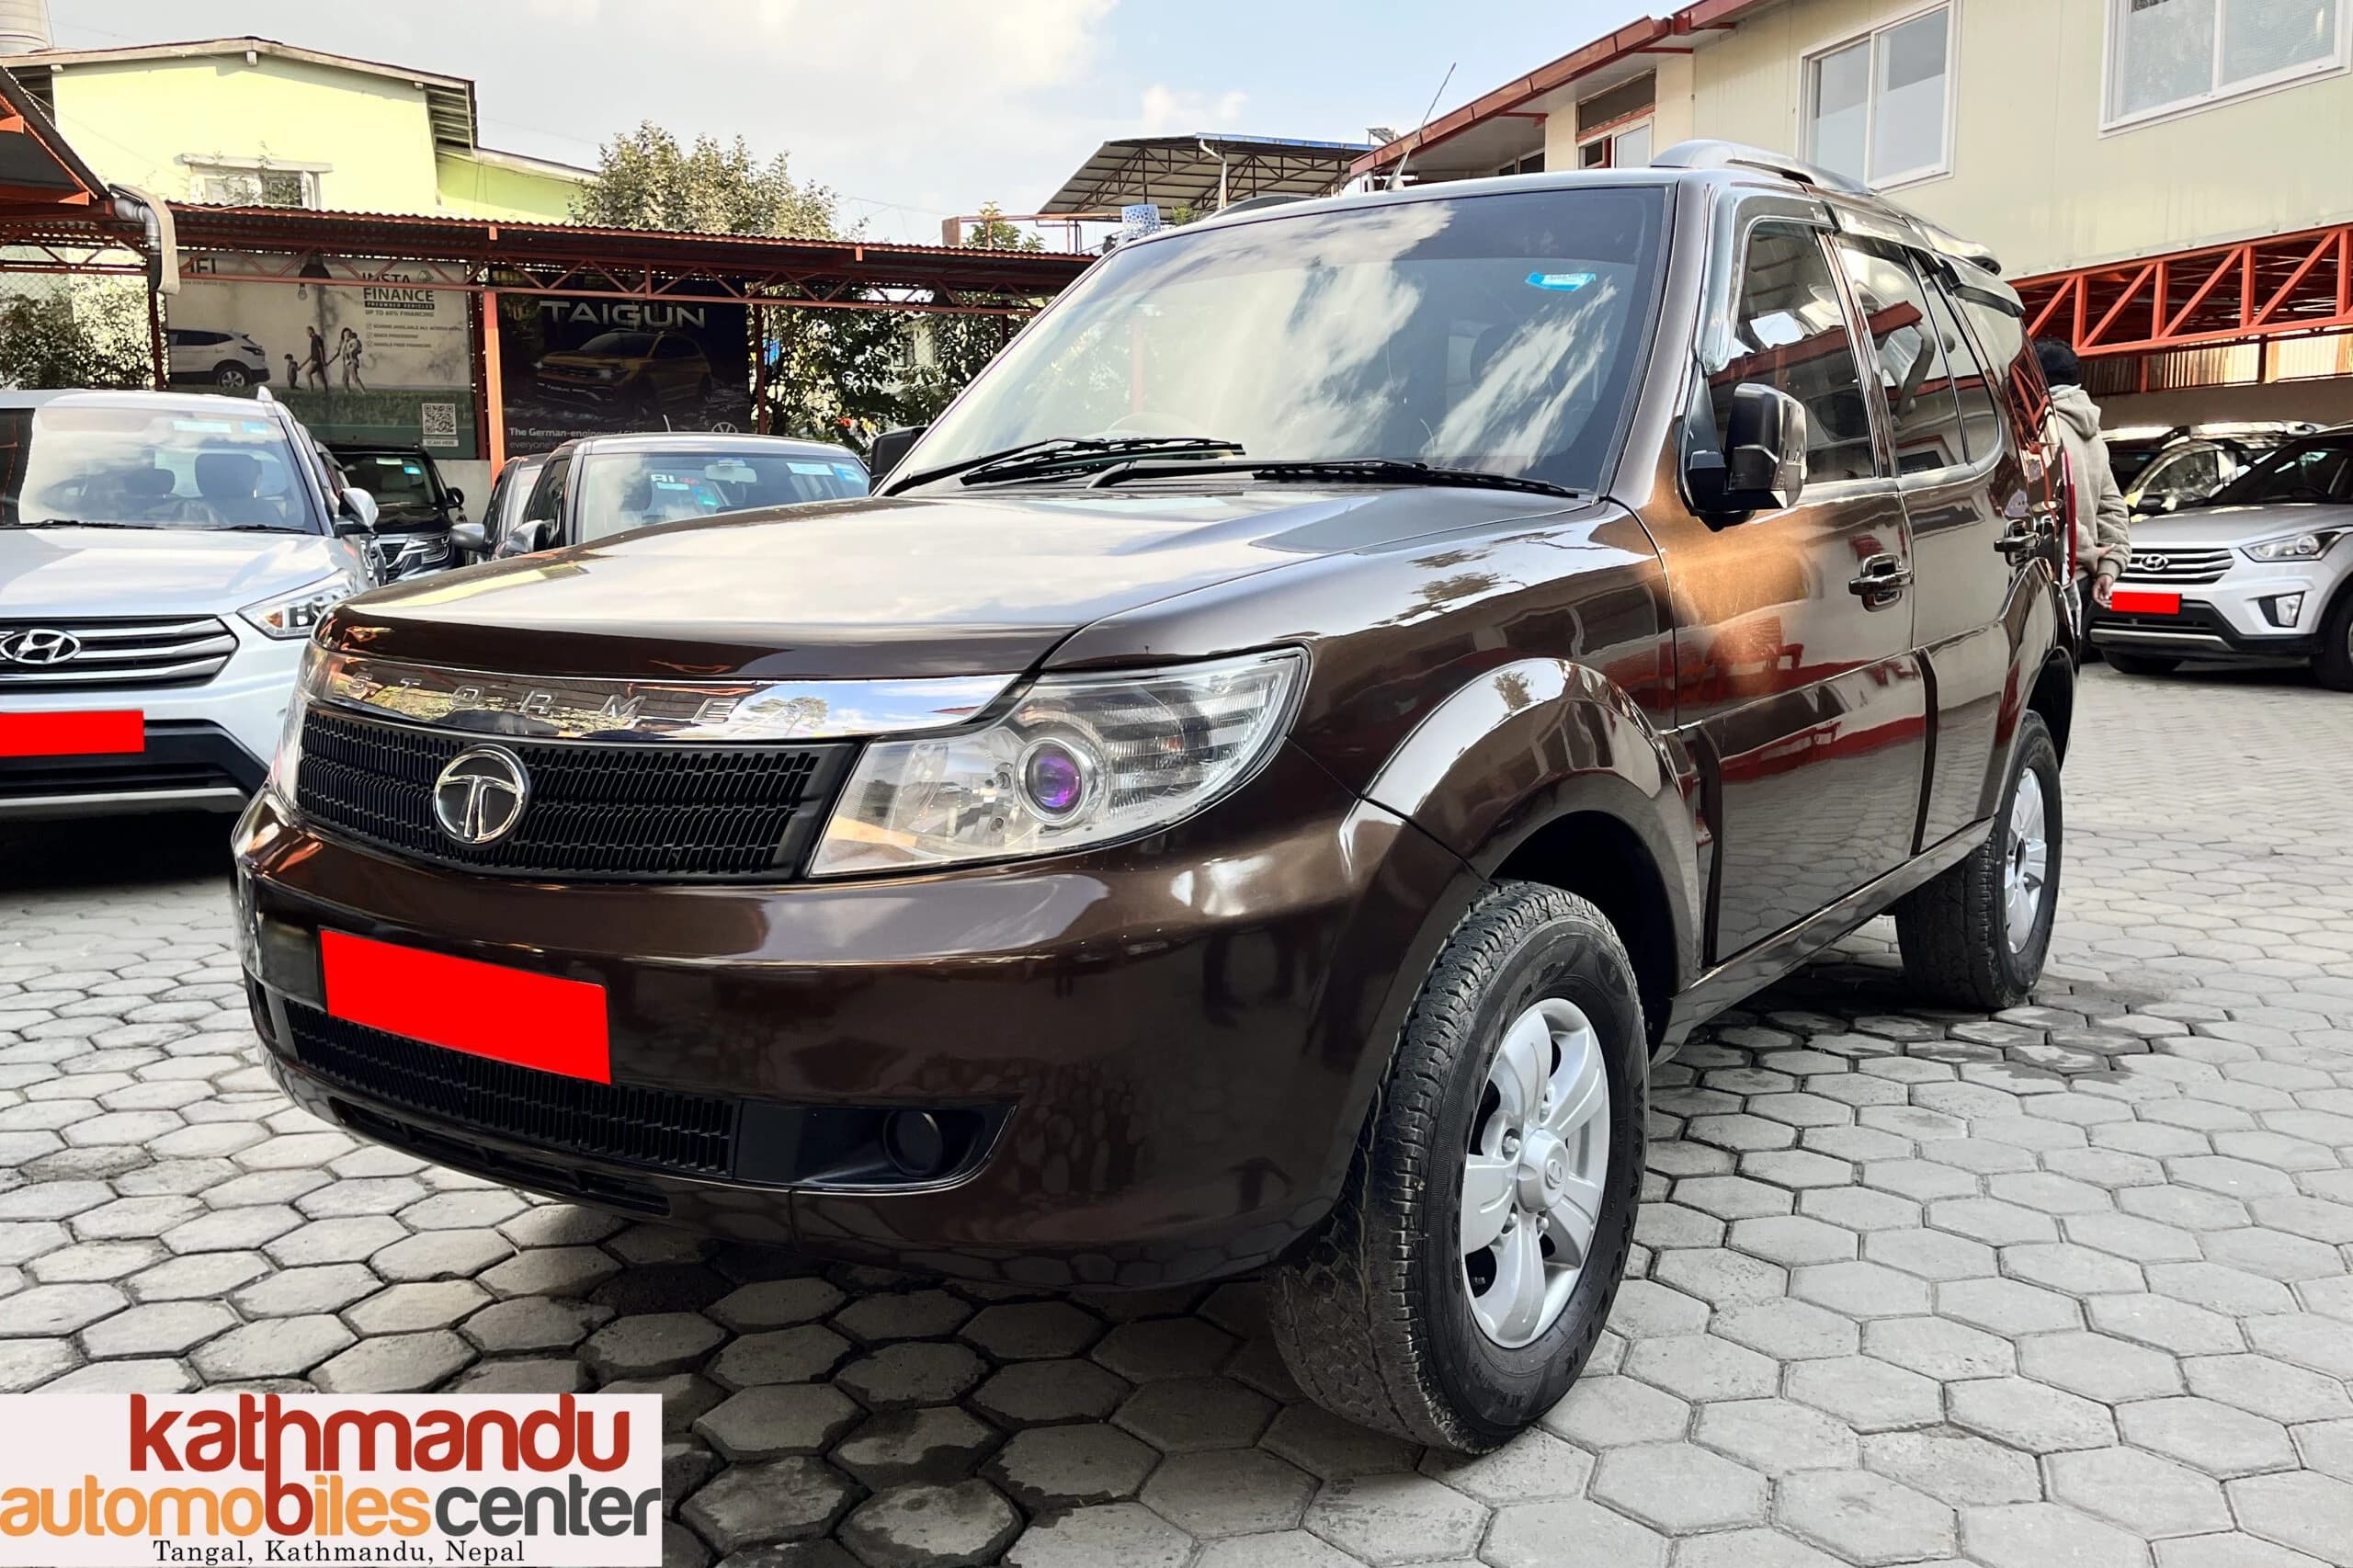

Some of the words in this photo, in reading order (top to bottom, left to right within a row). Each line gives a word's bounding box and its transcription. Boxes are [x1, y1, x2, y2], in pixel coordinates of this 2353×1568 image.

[363, 288, 435, 302] FINANCE
[539, 300, 706, 329] TAIGUN
[508, 426, 528, 437] The
[349, 672, 740, 724] STORME
